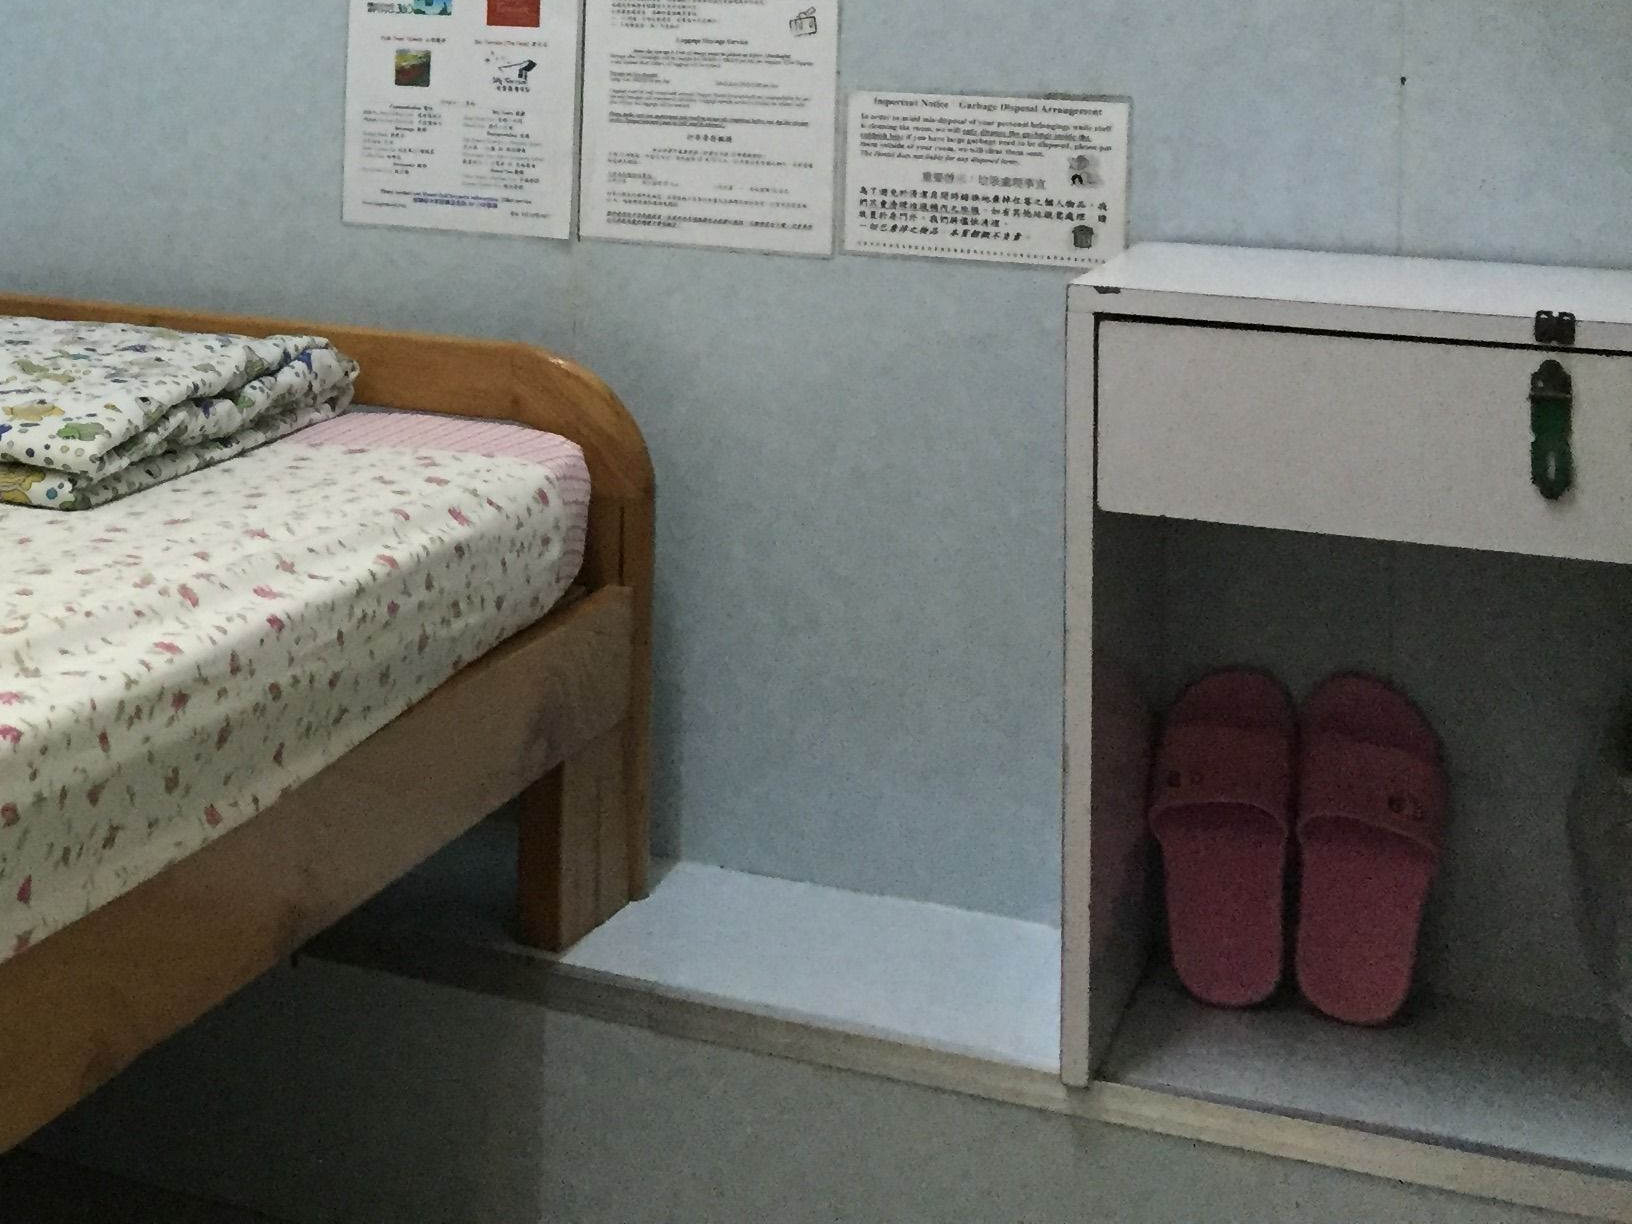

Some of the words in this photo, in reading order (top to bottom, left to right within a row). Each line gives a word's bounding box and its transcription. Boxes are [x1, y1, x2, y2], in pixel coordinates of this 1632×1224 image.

[874, 97, 918, 107] Important
[921, 99, 948, 109] Notice
[959, 101, 997, 112] Garbage
[1001, 104, 1037, 114] Disposal
[1041, 105, 1102, 116] Arrangement
